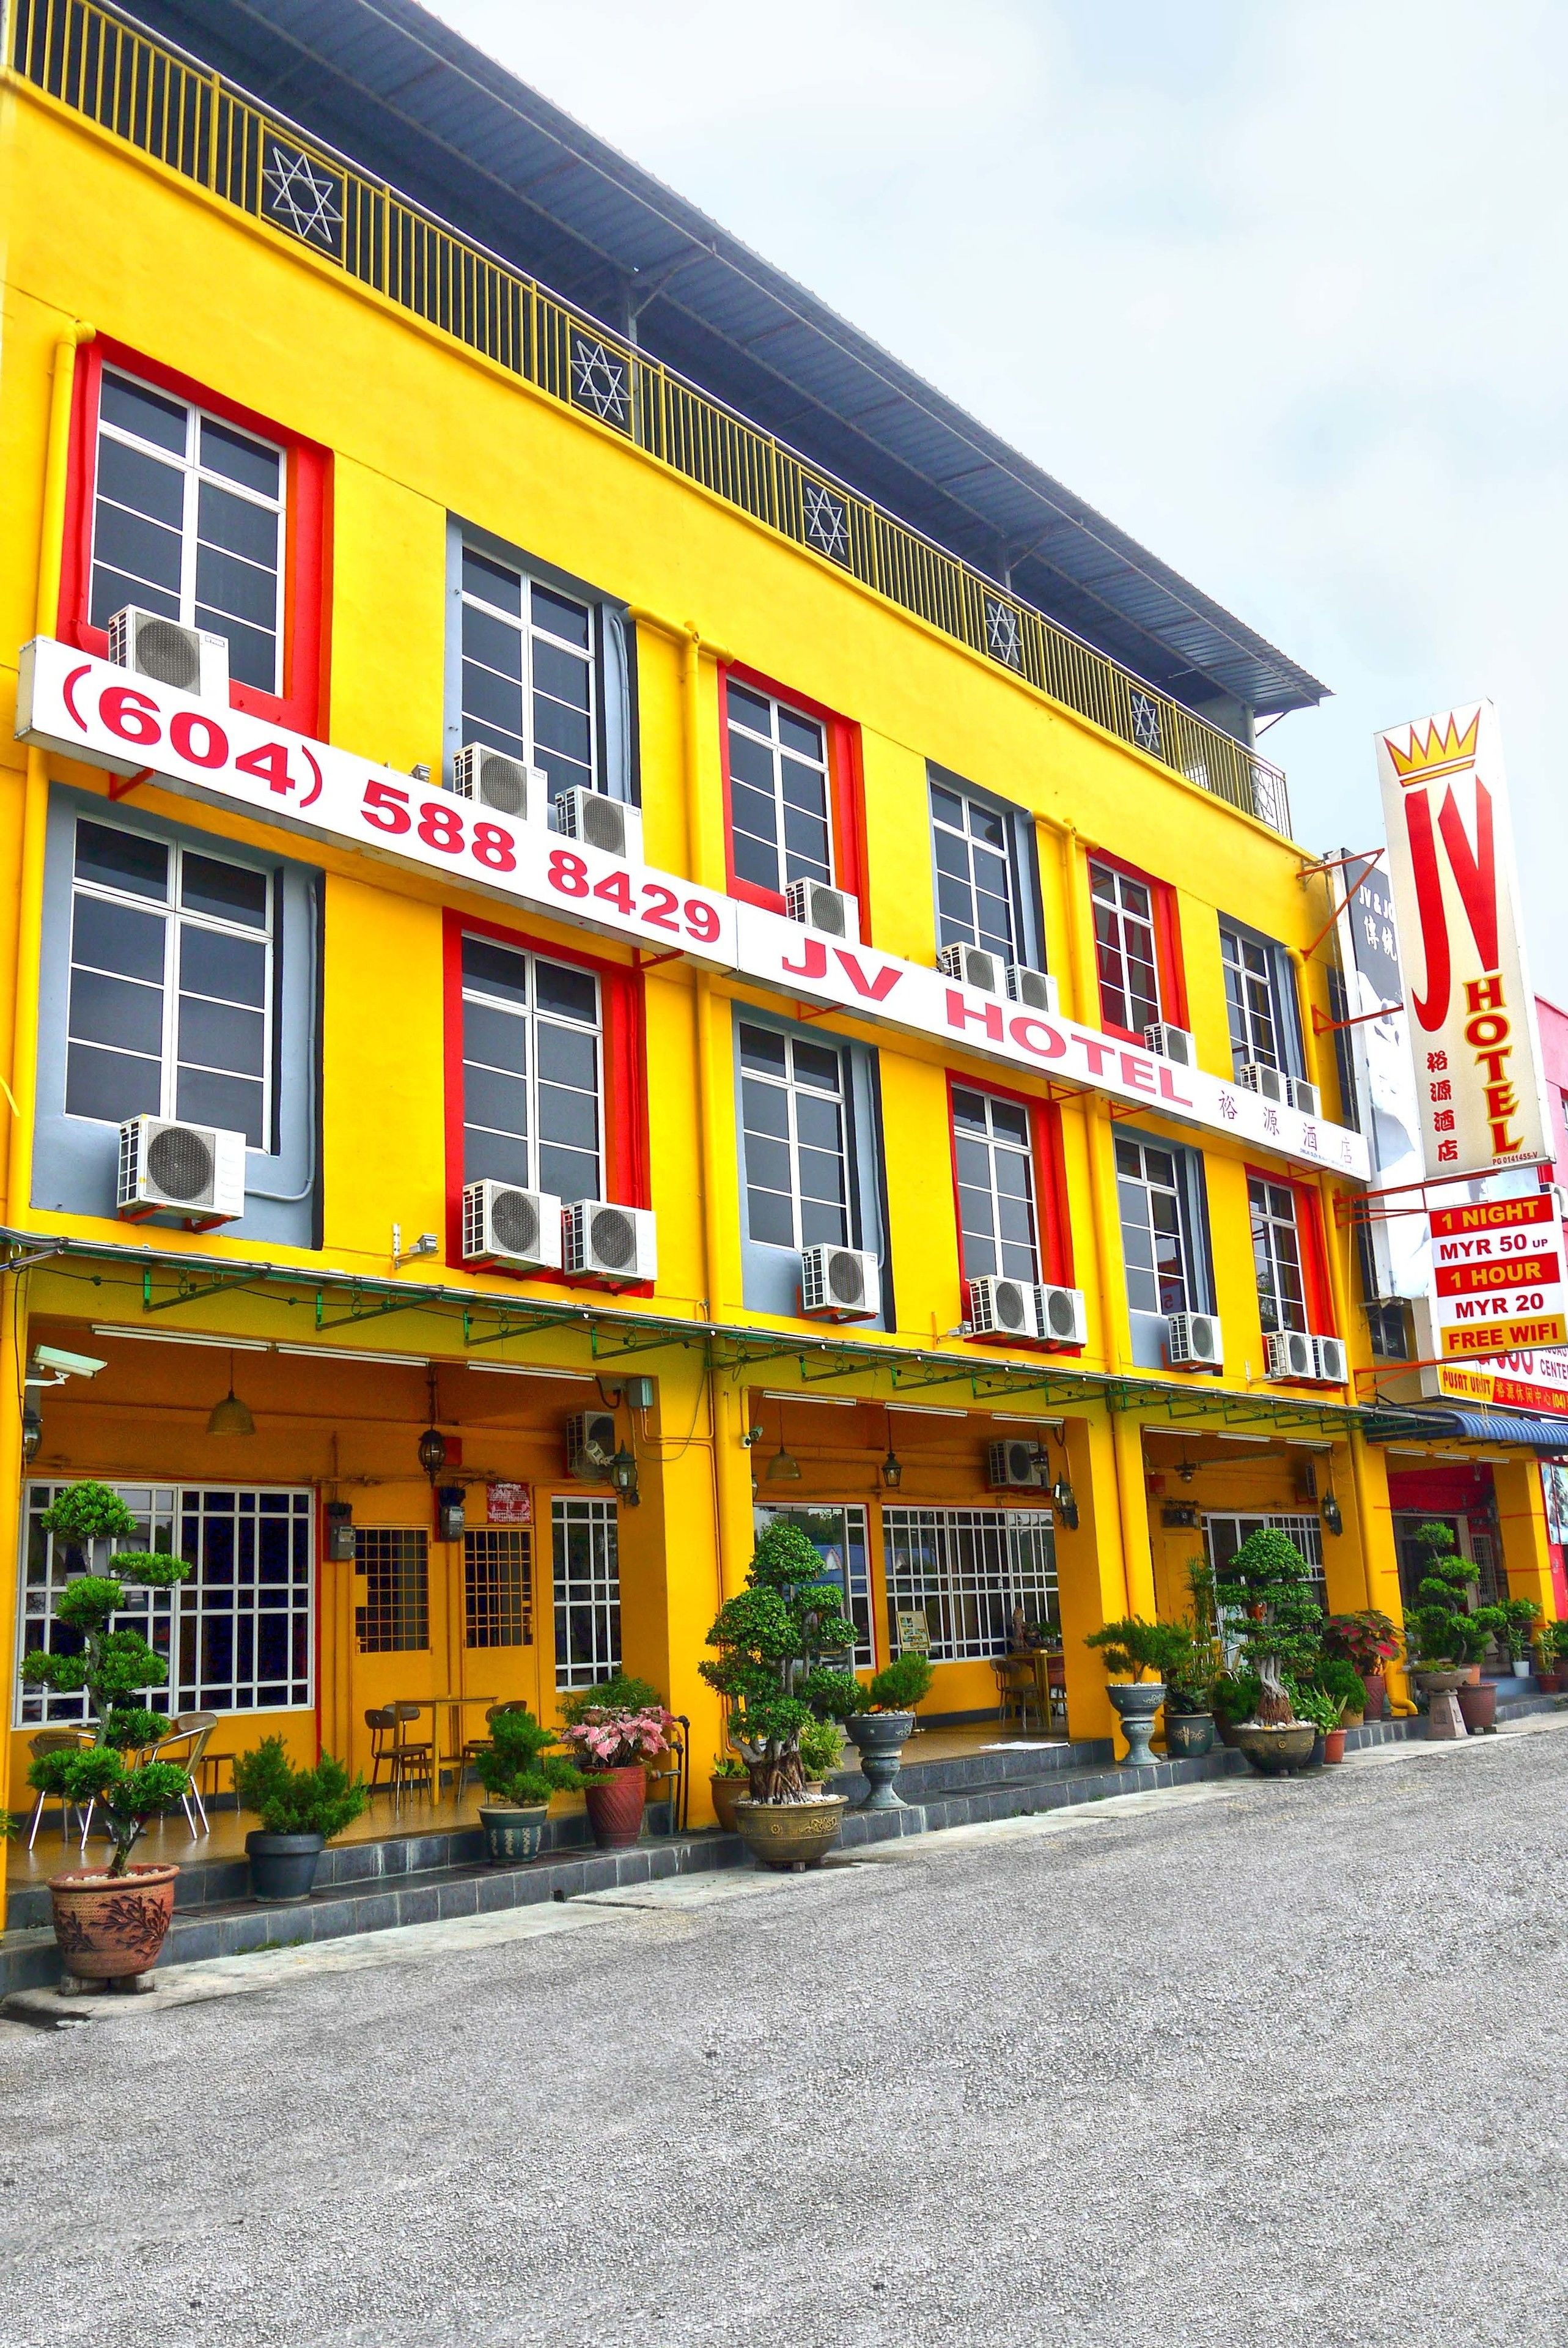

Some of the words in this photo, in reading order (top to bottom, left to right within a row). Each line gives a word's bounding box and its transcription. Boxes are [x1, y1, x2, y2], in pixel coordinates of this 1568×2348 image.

[62, 664, 323, 808] (604)
[361, 780, 517, 872] 588
[548, 849, 721, 943] 8429
[1405, 773, 1499, 1033] JV
[782, 938, 903, 1002] JV
[946, 989, 1193, 1107] HOTEL
[1462, 973, 1525, 1157] HOTEL
[1427, 1050, 1459, 1162] 裕源酒店
[1218, 1090, 1353, 1164] 裕源酒店
[1441, 1213, 1452, 1230] 1
[1462, 1200, 1539, 1228] NIGHT
[1440, 1238, 1492, 1261] MYR
[1500, 1234, 1527, 1252] 50
[1532, 1239, 1548, 1248] UP
[1450, 1271, 1462, 1288] 1
[1471, 1261, 1543, 1287] HOUR
[1455, 1297, 1509, 1319] MYR
[1515, 1293, 1544, 1312] 20
[1448, 1328, 1504, 1350] FREE
[1509, 1322, 1558, 1343] WIFI
[1443, 1370, 1468, 1391] PUSAT
[1540, 1359, 1568, 1380] CENTE
